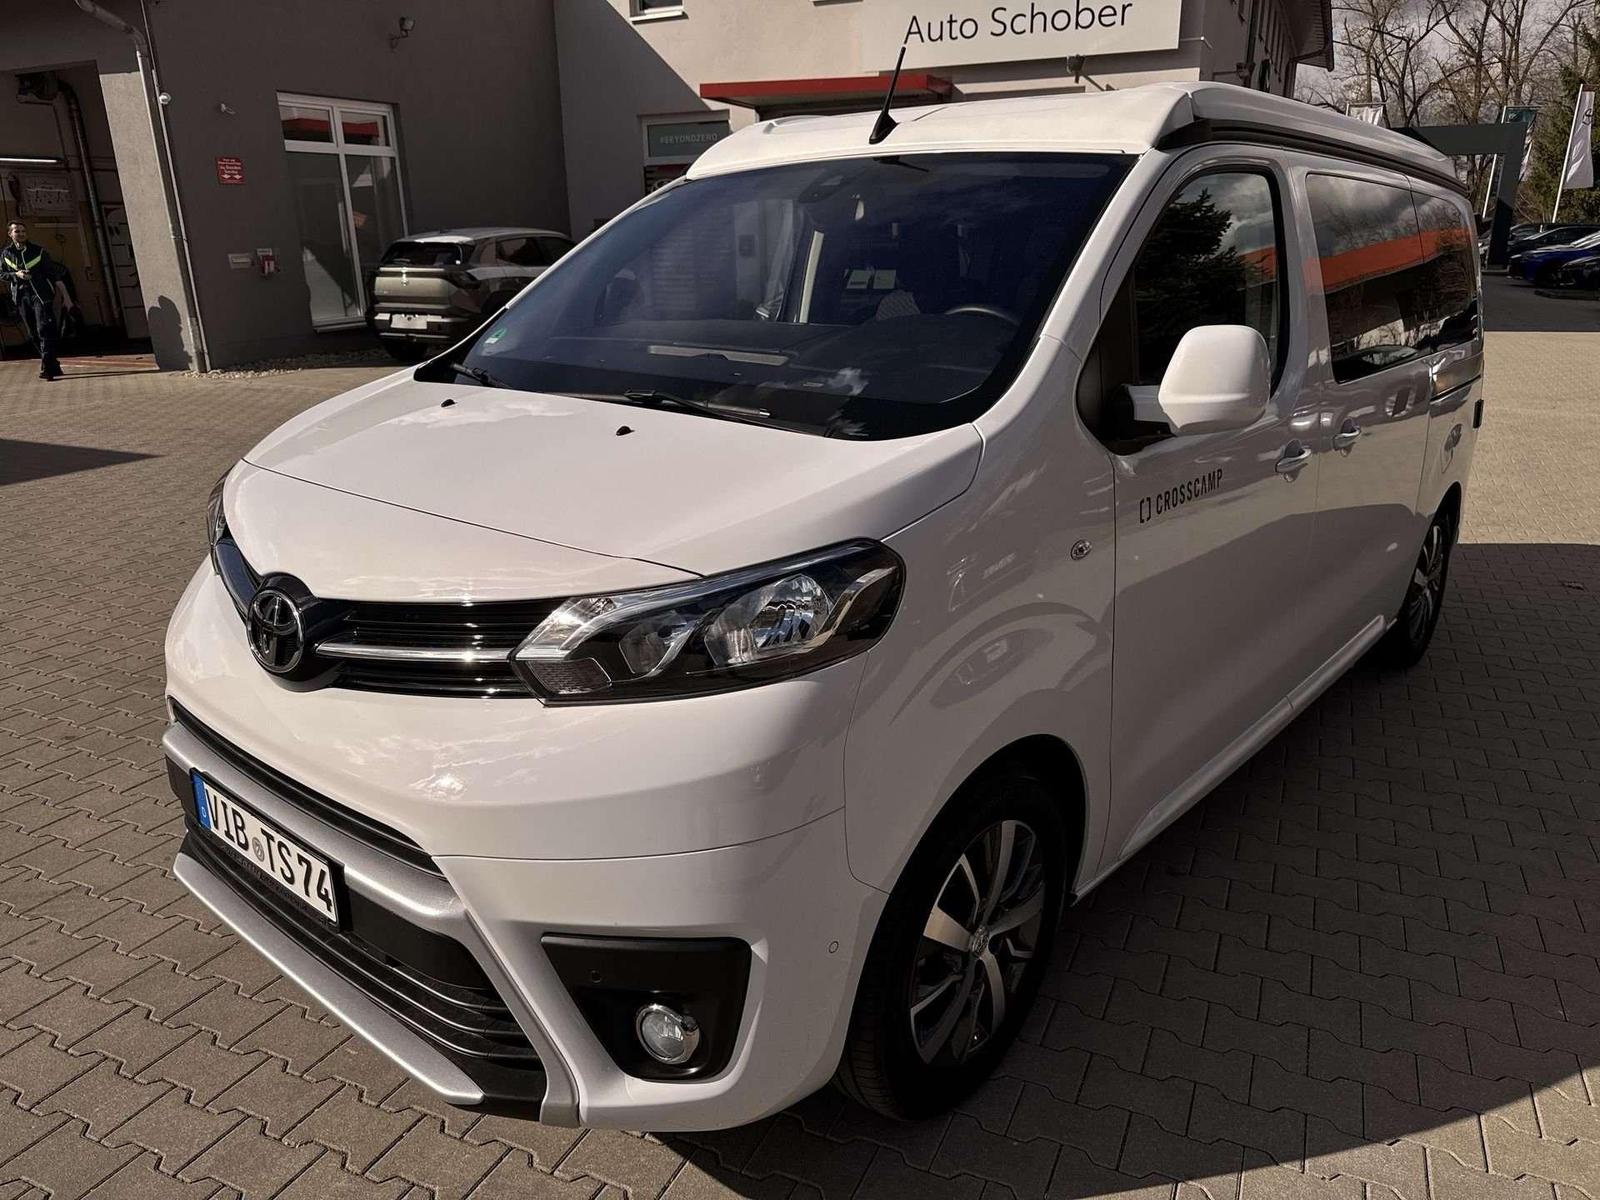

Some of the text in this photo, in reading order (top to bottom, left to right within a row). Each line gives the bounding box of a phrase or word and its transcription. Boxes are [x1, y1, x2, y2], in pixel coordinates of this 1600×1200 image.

[904, 0, 1133, 44] Auto Schober
[1156, 468, 1223, 515] CROSSCAMP
[207, 788, 249, 851] VIB
